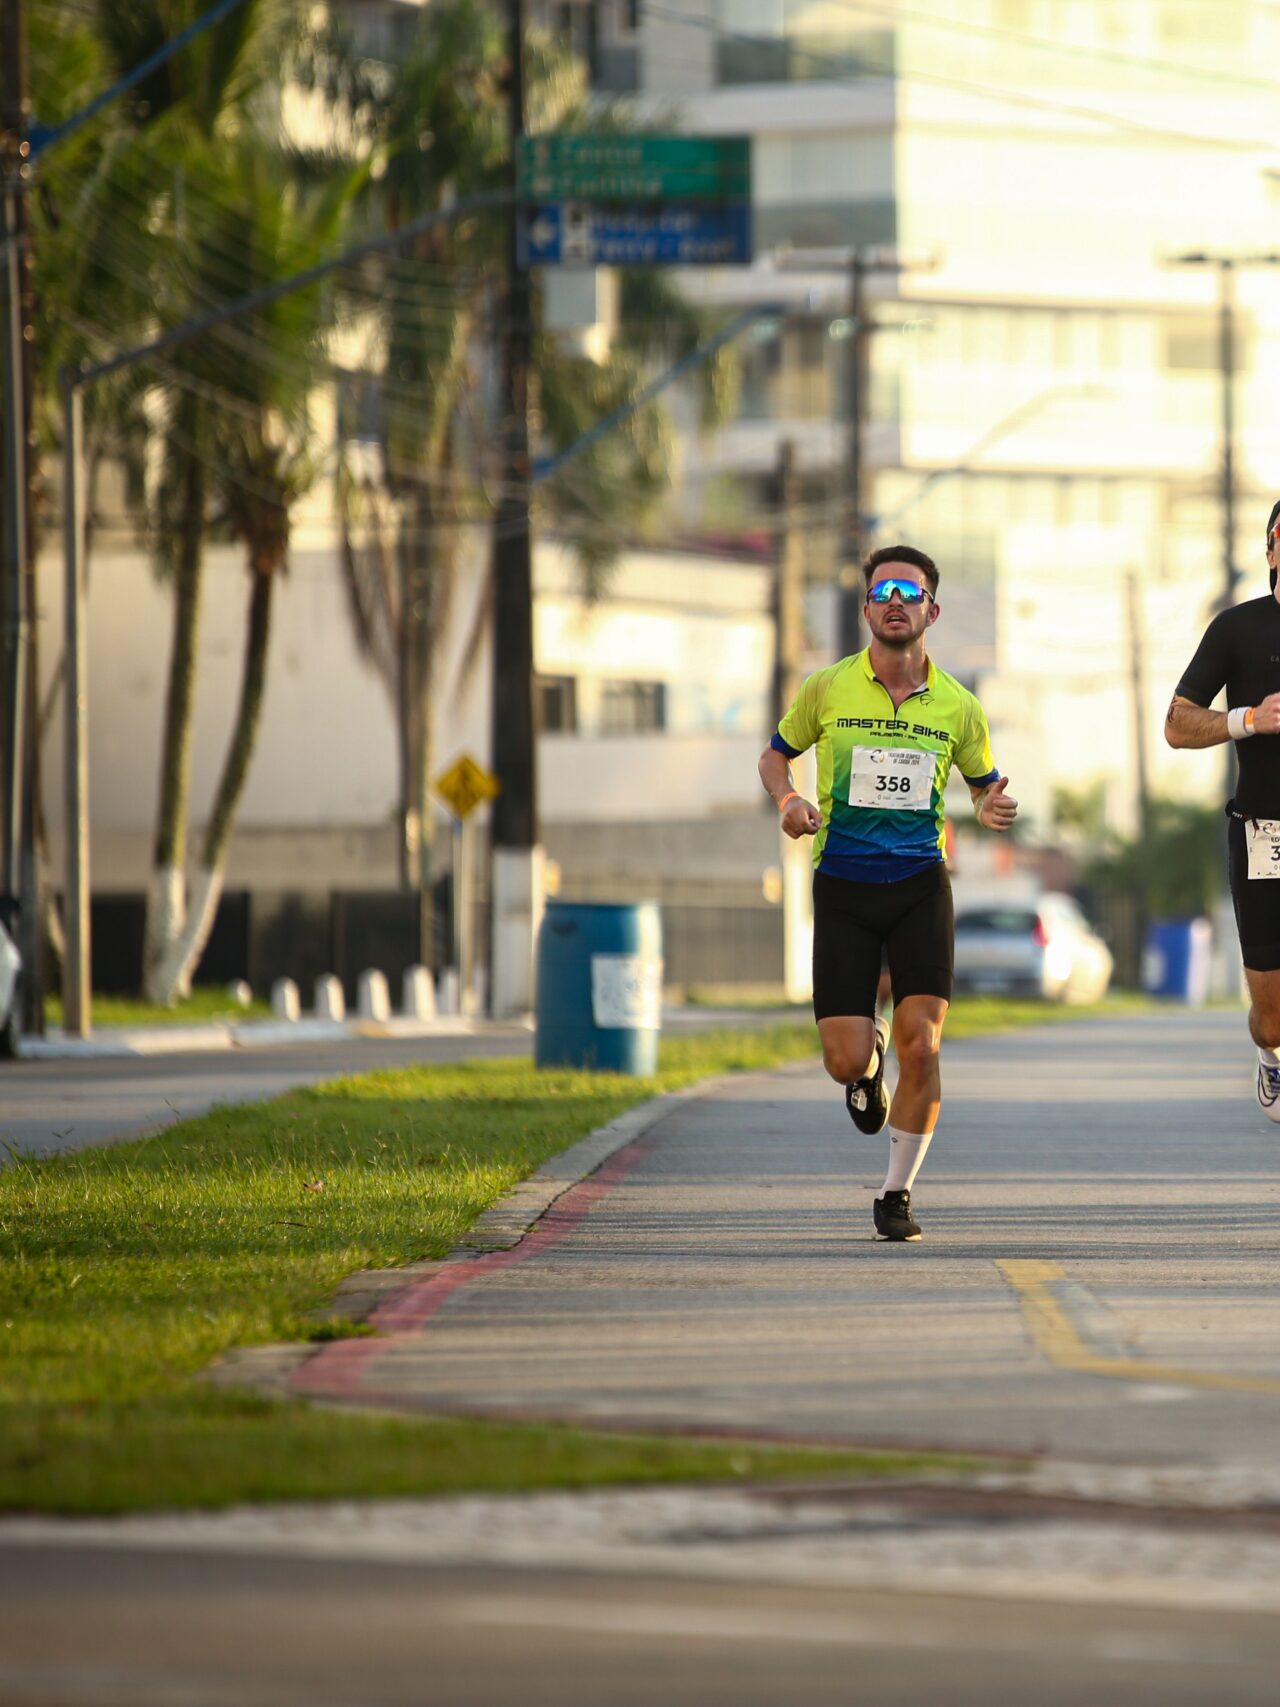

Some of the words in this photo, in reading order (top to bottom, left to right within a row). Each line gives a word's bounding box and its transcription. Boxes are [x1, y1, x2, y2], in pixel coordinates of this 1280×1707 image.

[836, 718, 909, 731] MASTER
[912, 724, 950, 742] BIKE
[875, 775, 911, 793] 358
